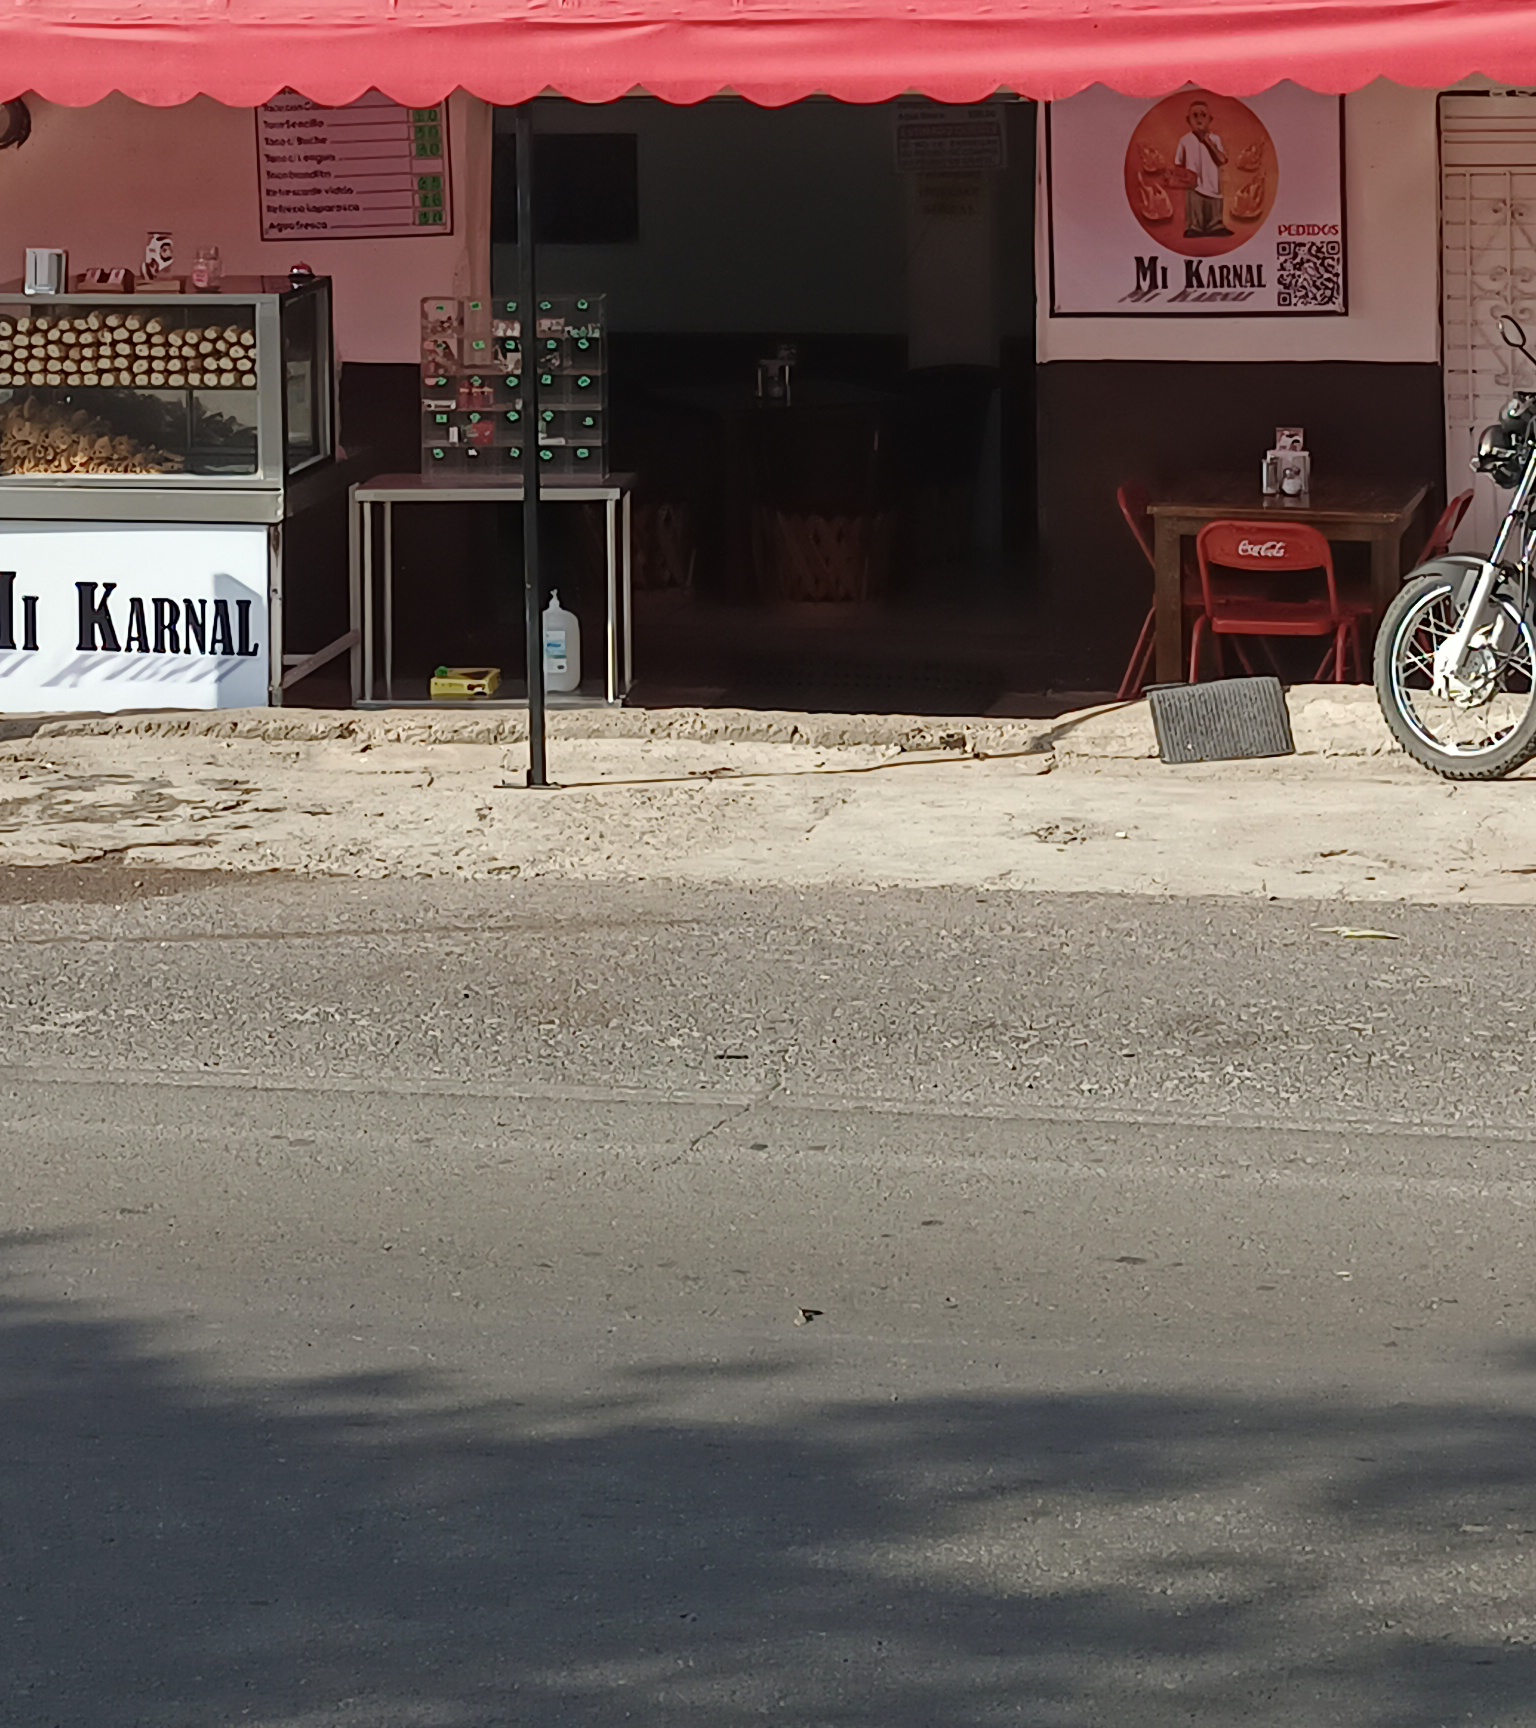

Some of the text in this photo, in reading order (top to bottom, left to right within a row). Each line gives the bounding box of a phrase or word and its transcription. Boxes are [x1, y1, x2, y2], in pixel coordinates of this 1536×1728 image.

[1278, 224, 1339, 236] PEDIDOS
[1184, 259, 1267, 289] KARNAL
[74, 581, 260, 658] KARNAL
